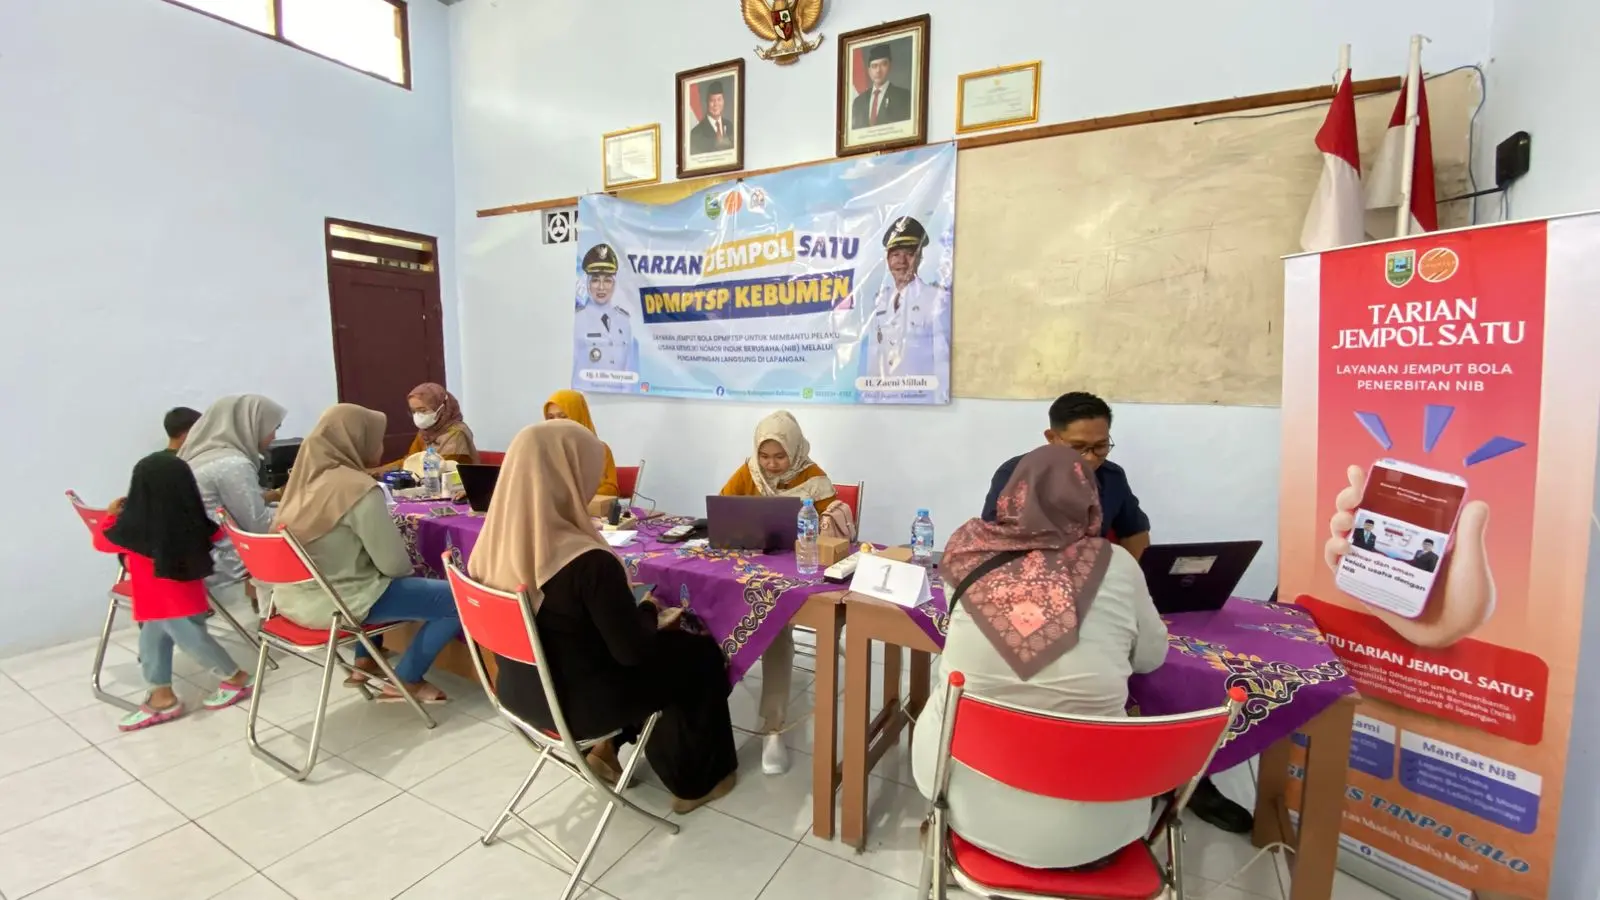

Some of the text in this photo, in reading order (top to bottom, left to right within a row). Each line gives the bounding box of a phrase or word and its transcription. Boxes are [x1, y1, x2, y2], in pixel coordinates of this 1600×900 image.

[627, 235, 860, 275] TARIAN JEMPOL SATU
[645, 276, 850, 314] DPMPTSP KEBUMEN
[1368, 297, 1478, 325] TARIAN
[769, 332, 810, 341] MEMBANTU
[1332, 320, 1526, 350] JEMPOL SATU
[1336, 363, 1512, 375] LAYANAN JEMPUT BOLA
[1357, 380, 1484, 392] PENERBITAN NIB
[873, 564, 894, 594] 1
[1394, 574, 1426, 592] dengan
[1348, 640, 1404, 666] TARIAN
[1406, 658, 1473, 685] JEMPOL
[1476, 676, 1534, 702] SATU?
[1352, 718, 1381, 734] ami
[1422, 742, 1518, 782] Manfaat NIB
[1369, 794, 1453, 839] TANPA
[1456, 832, 1530, 874] CALO
